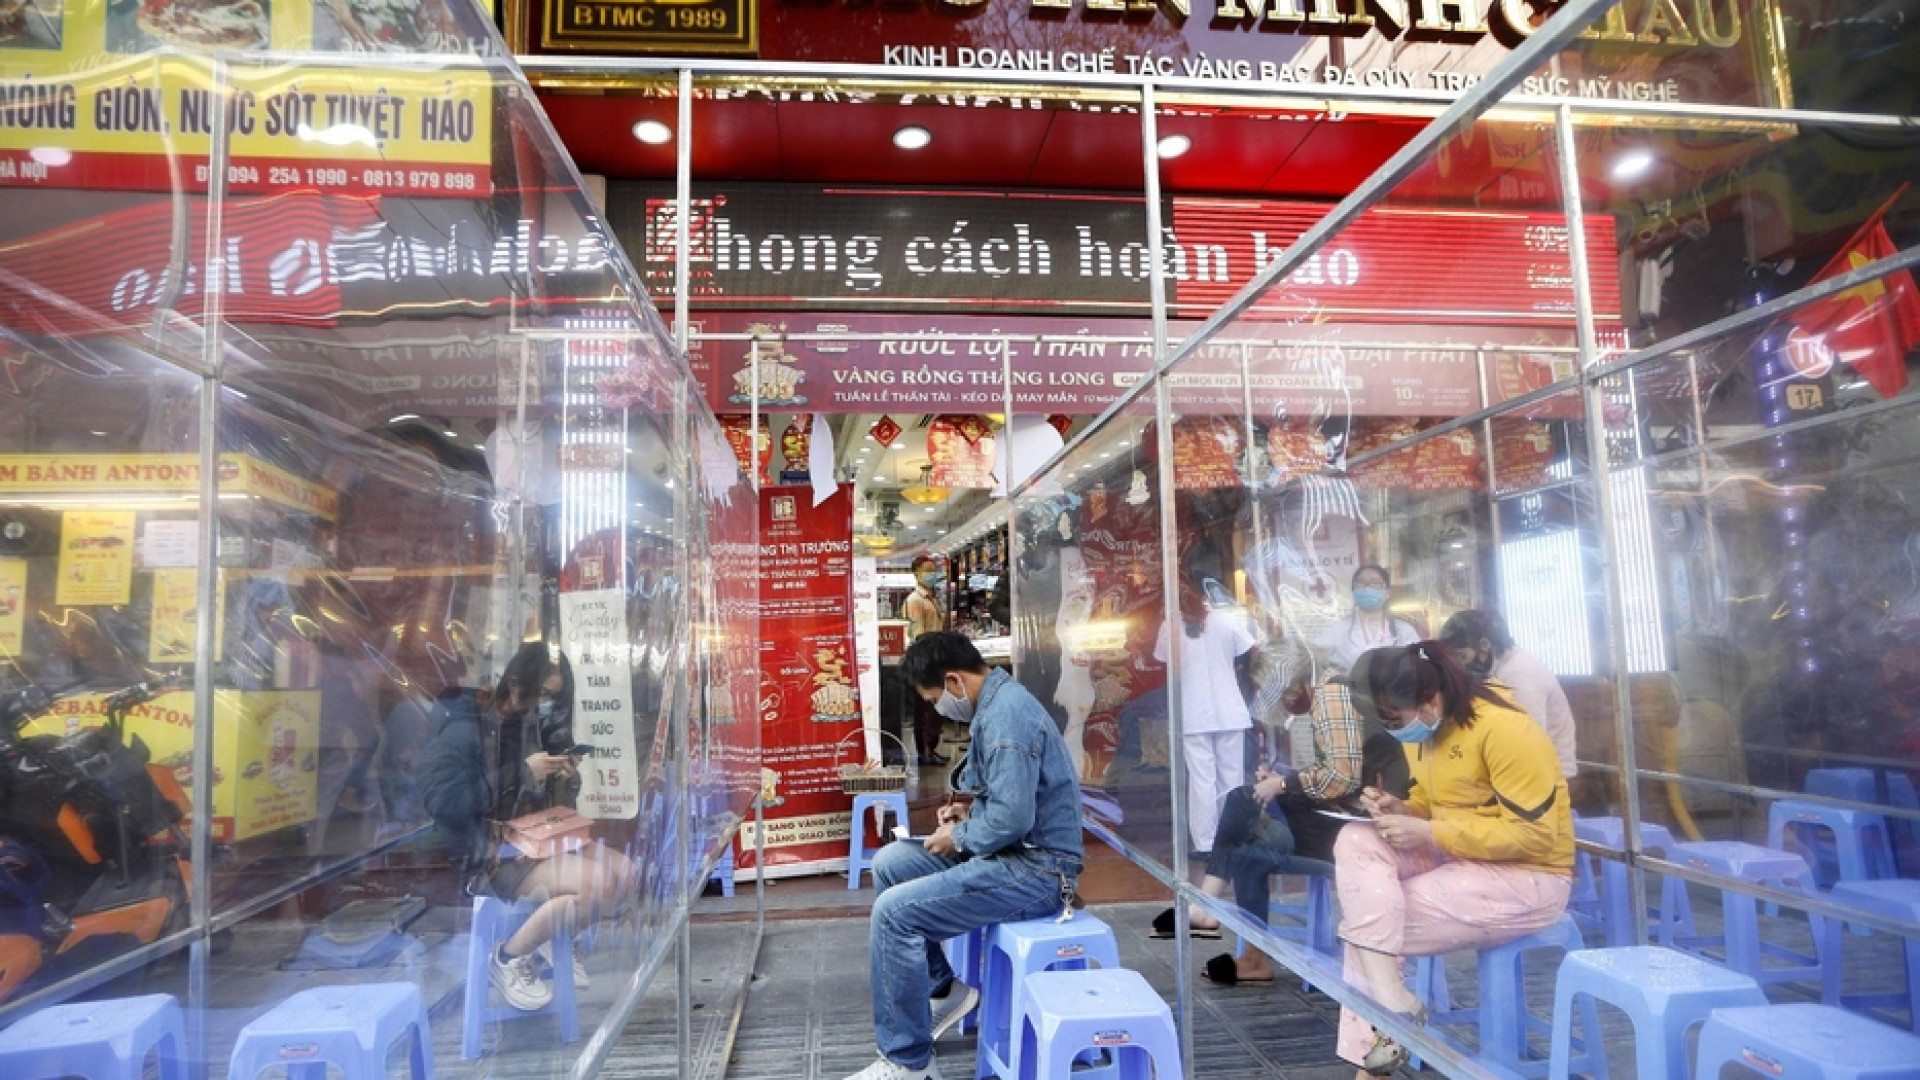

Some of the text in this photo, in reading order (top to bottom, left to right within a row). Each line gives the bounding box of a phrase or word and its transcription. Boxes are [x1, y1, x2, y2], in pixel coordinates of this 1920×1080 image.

[574, 6, 728, 28] BTMC 1989
[883, 45, 948, 67] KINH
[958, 47, 1053, 72] DOANH
[1061, 46, 1116, 74] CHẾ
[1124, 51, 1174, 76] TÁC
[1182, 51, 1252, 80] VÀNG
[269, 167, 301, 185] 254
[306, 168, 347, 186] 1990
[363, 170, 404, 188] 0813
[409, 171, 439, 188] 979
[444, 172, 475, 190] 898
[713, 217, 883, 291] hong
[905, 220, 1052, 278] cách
[1049, 371, 1105, 386] LONG
[26, 459, 97, 482] BÁNH
[582, 699, 621, 712] TRANG
[598, 769, 620, 787] 15
